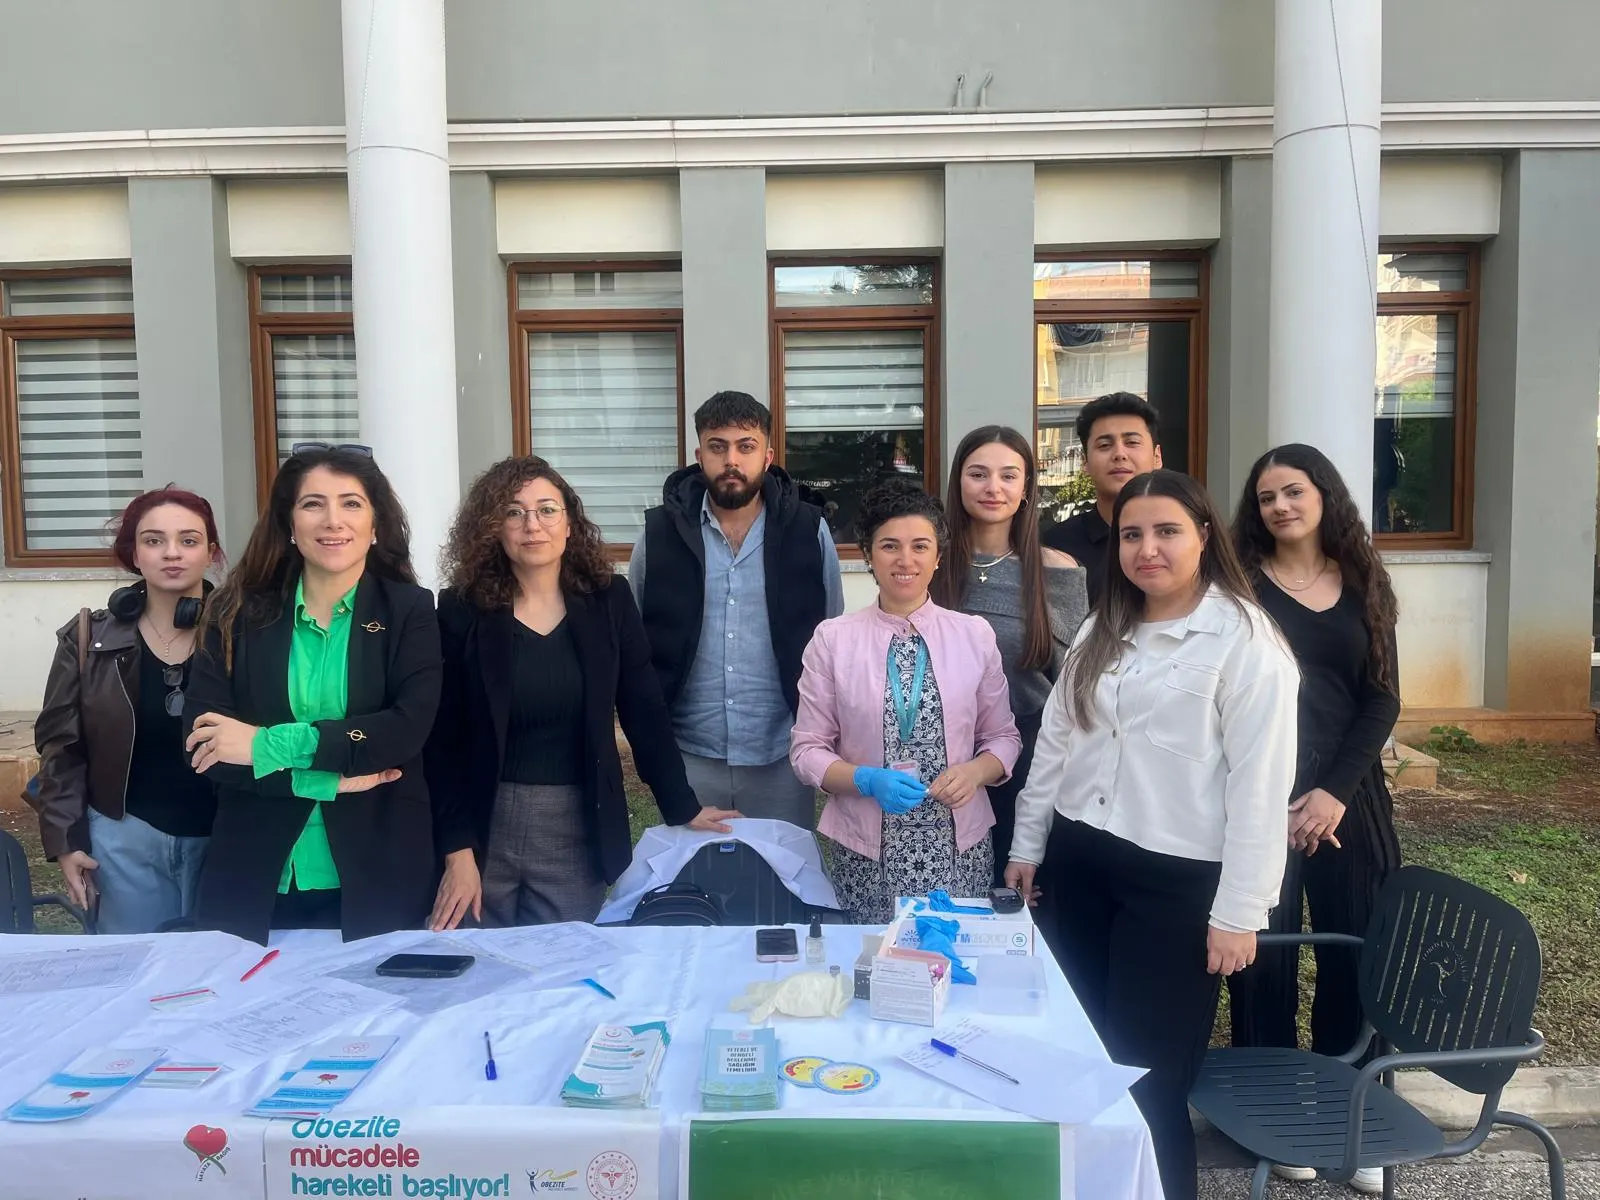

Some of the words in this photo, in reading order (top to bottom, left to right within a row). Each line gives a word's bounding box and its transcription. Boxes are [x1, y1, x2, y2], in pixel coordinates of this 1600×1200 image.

[291, 1115, 400, 1139] Obezite
[290, 1143, 420, 1168] mücadele
[291, 1172, 392, 1196] hareketi
[402, 1173, 510, 1200] başlıyor!
